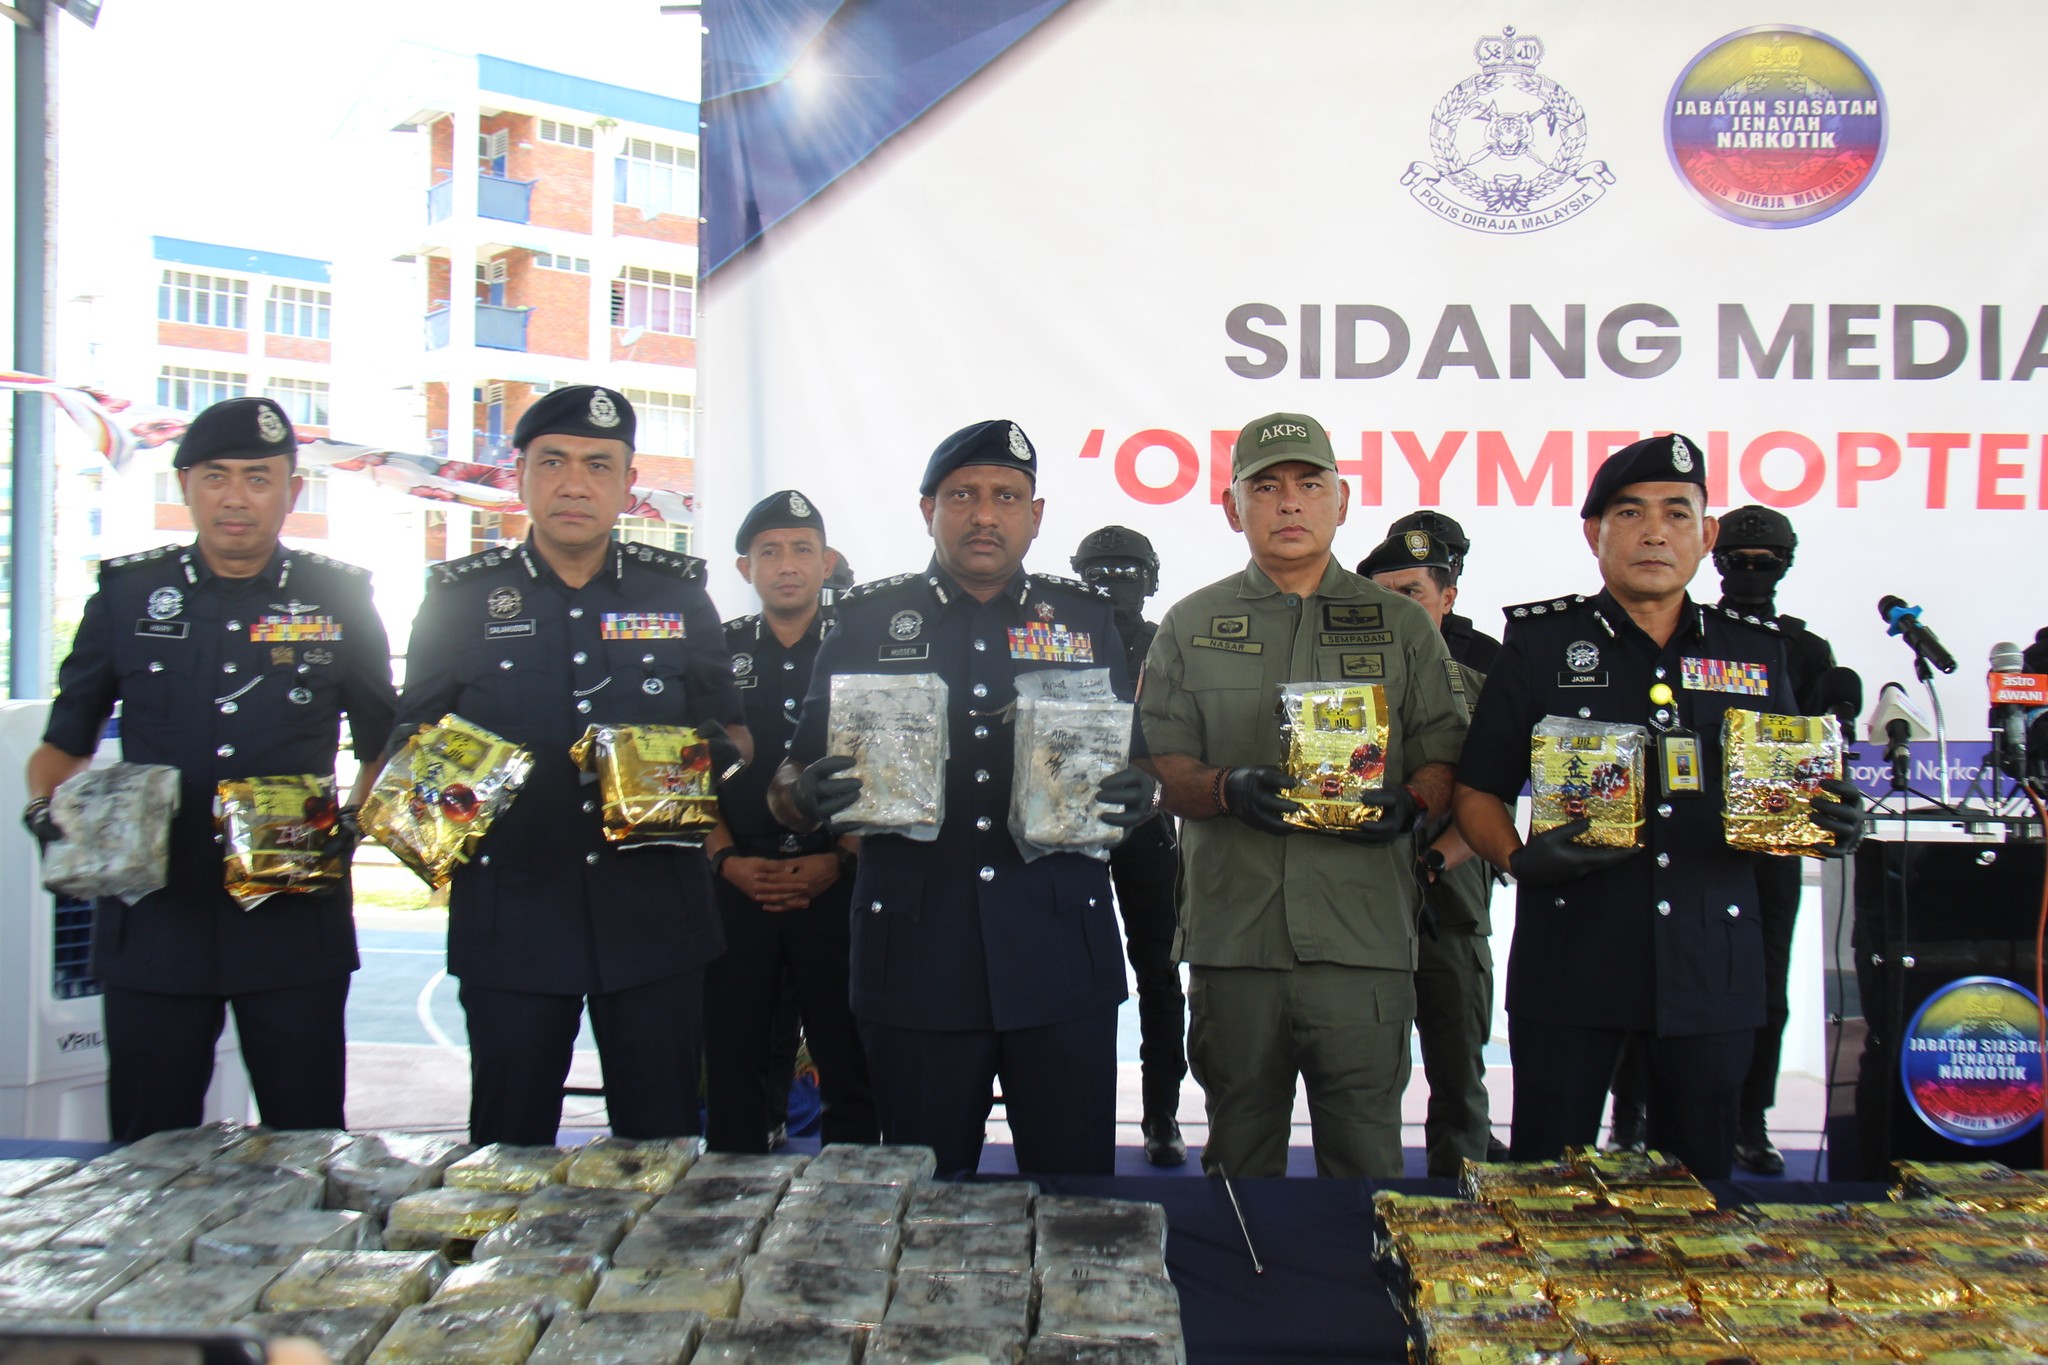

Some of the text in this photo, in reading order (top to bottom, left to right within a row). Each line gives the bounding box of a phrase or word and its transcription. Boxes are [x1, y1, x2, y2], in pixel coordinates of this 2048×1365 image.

[1674, 99, 1877, 116] JABATAN SIASATAN
[1731, 116, 1820, 131] JENAYAH
[1717, 131, 1836, 149] NARKOTIK
[1695, 167, 1858, 209] POLIS DIRAJA MALAYSIA
[1419, 188, 1594, 231] POLIS DIRAJA MALAYSIA
[1224, 302, 1683, 380] SIDANG
[1259, 423, 1307, 443] AKPS
[1209, 639, 1245, 651] NASAR
[1327, 634, 1386, 644] SEMPADAN
[1571, 675, 1596, 683] JASMIN
[2002, 676, 2036, 687] astro
[1998, 689, 2043, 701] AWANI
[1909, 1037, 2048, 1054] JABATAN SIASAT
[1949, 1051, 2017, 1066] JENAYAH
[1937, 1063, 2027, 1081] NARKOTIK
